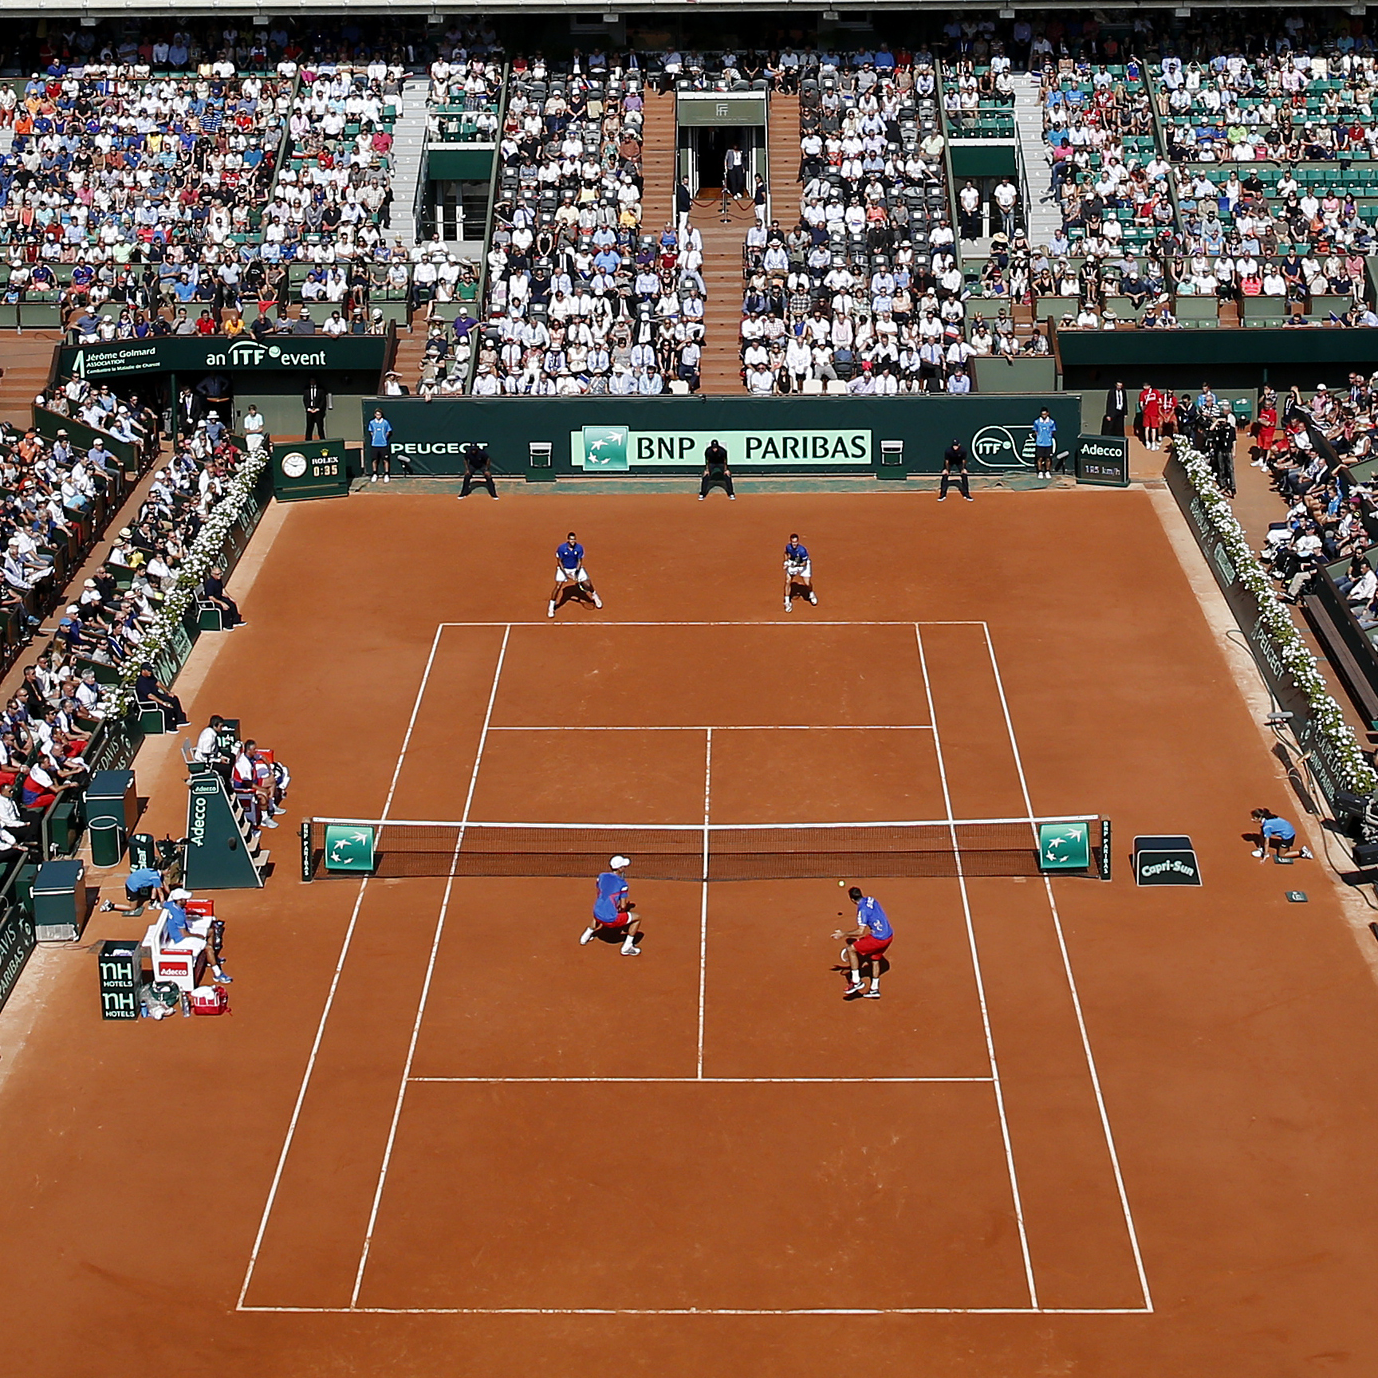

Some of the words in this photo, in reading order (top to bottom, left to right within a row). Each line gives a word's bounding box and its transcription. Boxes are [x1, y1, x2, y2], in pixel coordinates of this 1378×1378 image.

[86, 353, 118, 362] Jérôme
[206, 353, 226, 365] an
[233, 349, 265, 365] ITF
[281, 351, 326, 365] event
[637, 437, 696, 460] BNP
[745, 435, 867, 460] PARIBAS
[978, 443, 1001, 455] ITF
[1080, 443, 1123, 458] Adecco
[312, 456, 339, 465] ROLEX
[313, 464, 338, 477] 0:35
[190, 797, 207, 847] Adecco
[1141, 860, 1195, 877] Capri-Sun
[160, 968, 188, 976] Adecco
[105, 1010, 136, 1018] HOTELS
